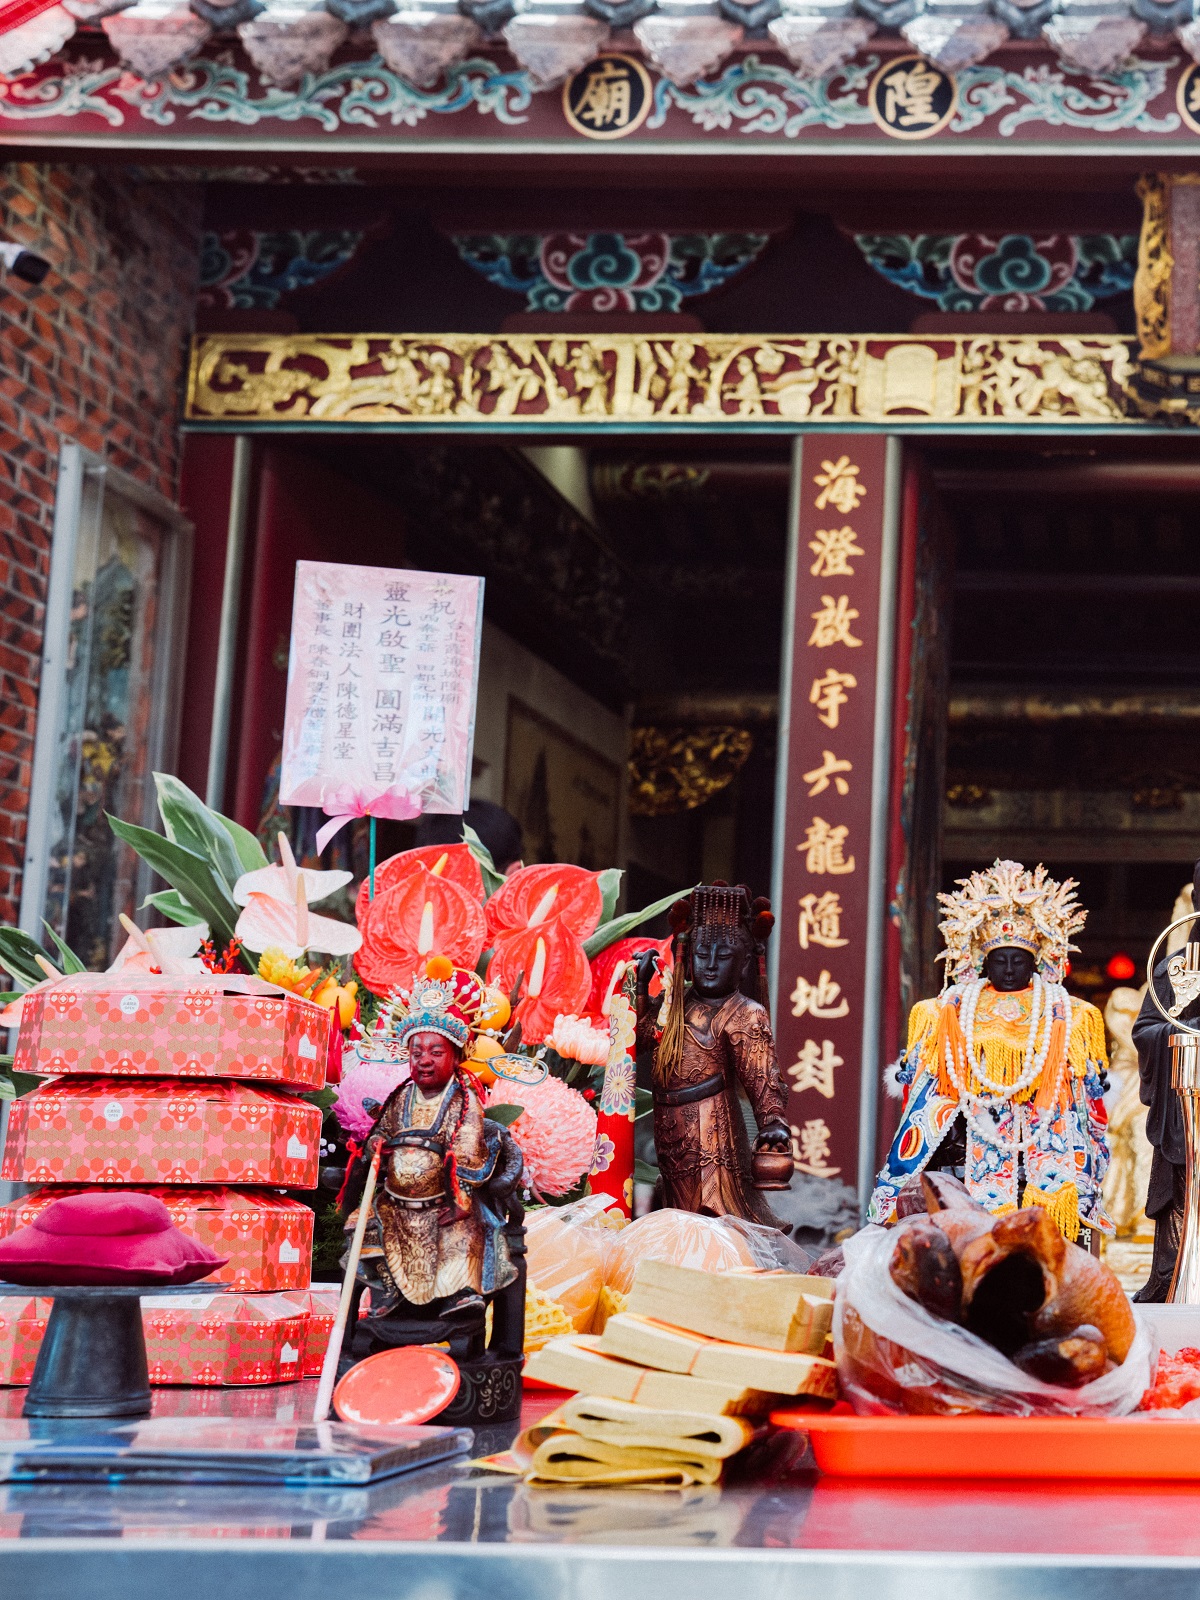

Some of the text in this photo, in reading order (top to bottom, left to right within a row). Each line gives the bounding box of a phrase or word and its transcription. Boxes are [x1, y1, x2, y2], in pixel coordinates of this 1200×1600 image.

[332, 602, 366, 760] 財團法人陳德星堂
[370, 581, 412, 783] 靈光啟聖 圓滿吉昌
